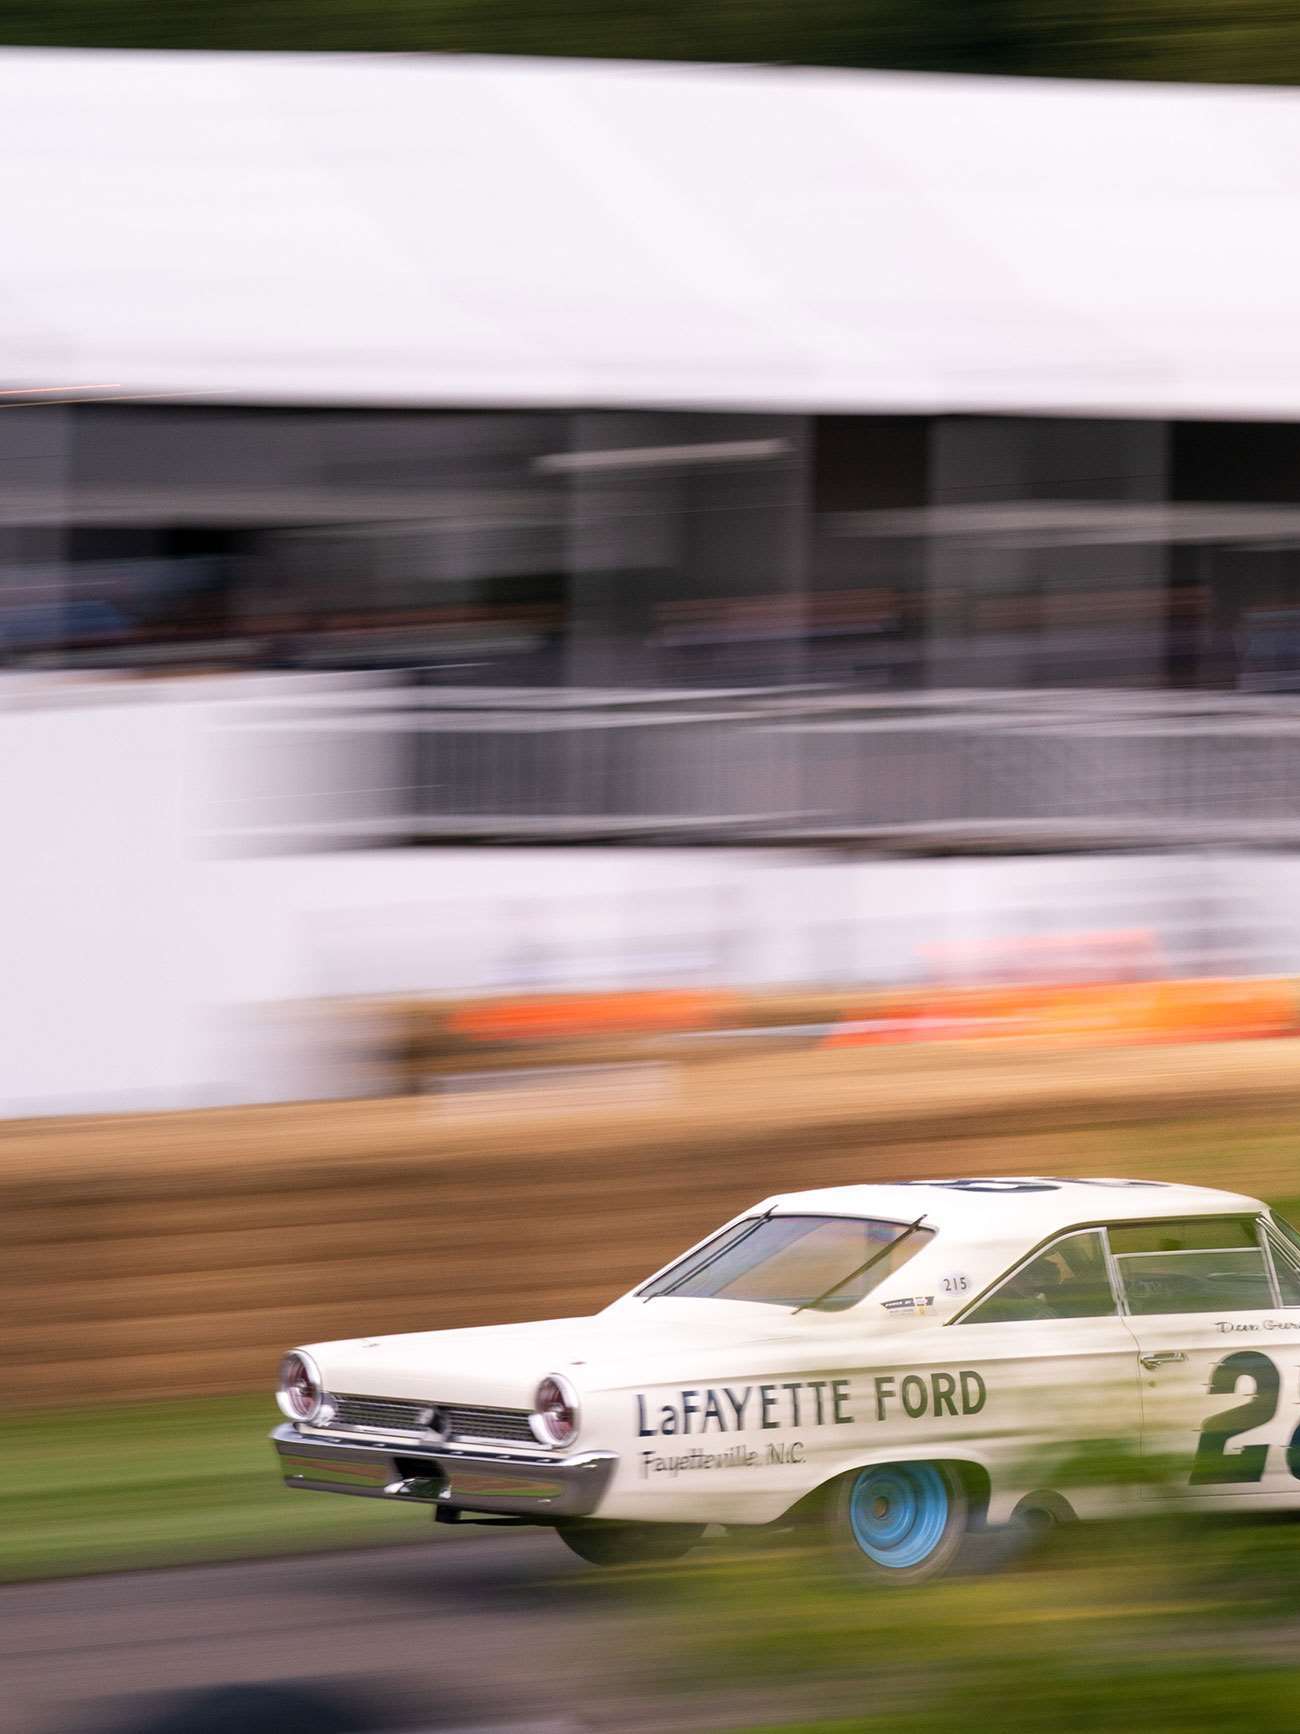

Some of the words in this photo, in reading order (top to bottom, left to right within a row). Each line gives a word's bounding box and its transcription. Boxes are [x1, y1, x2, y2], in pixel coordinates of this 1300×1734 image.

[943, 1276, 968, 1292] 215
[637, 1380, 854, 1437] LaFAYETTE
[874, 1370, 987, 1421] FORD
